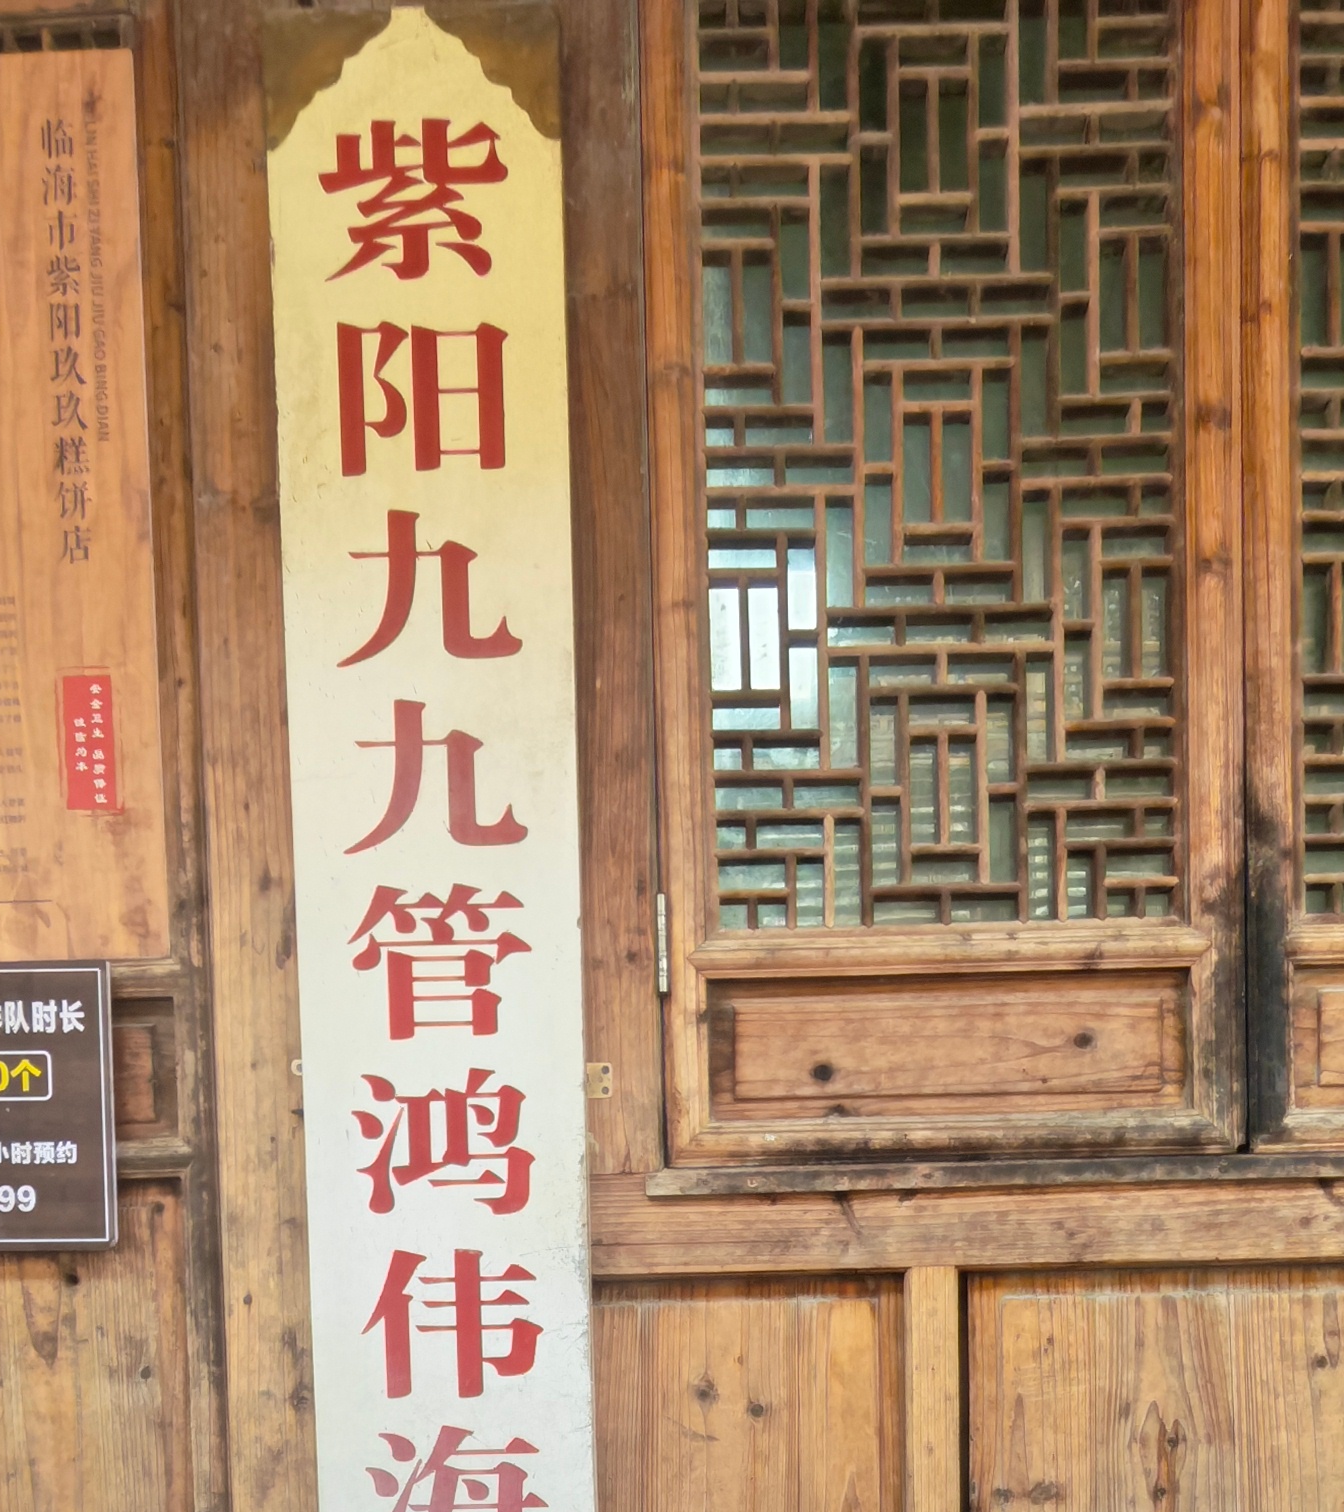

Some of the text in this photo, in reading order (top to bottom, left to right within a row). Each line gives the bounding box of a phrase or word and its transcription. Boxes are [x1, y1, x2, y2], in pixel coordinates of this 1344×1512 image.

[88, 225, 103, 268] YANG
[91, 272, 104, 297] JIU
[92, 300, 105, 325] JIU
[40, 117, 93, 565] 临海市紫阳玖玖糕饼店
[94, 328, 106, 360] GAO
[95, 363, 108, 402] BING
[96, 404, 110, 442] DIAN
